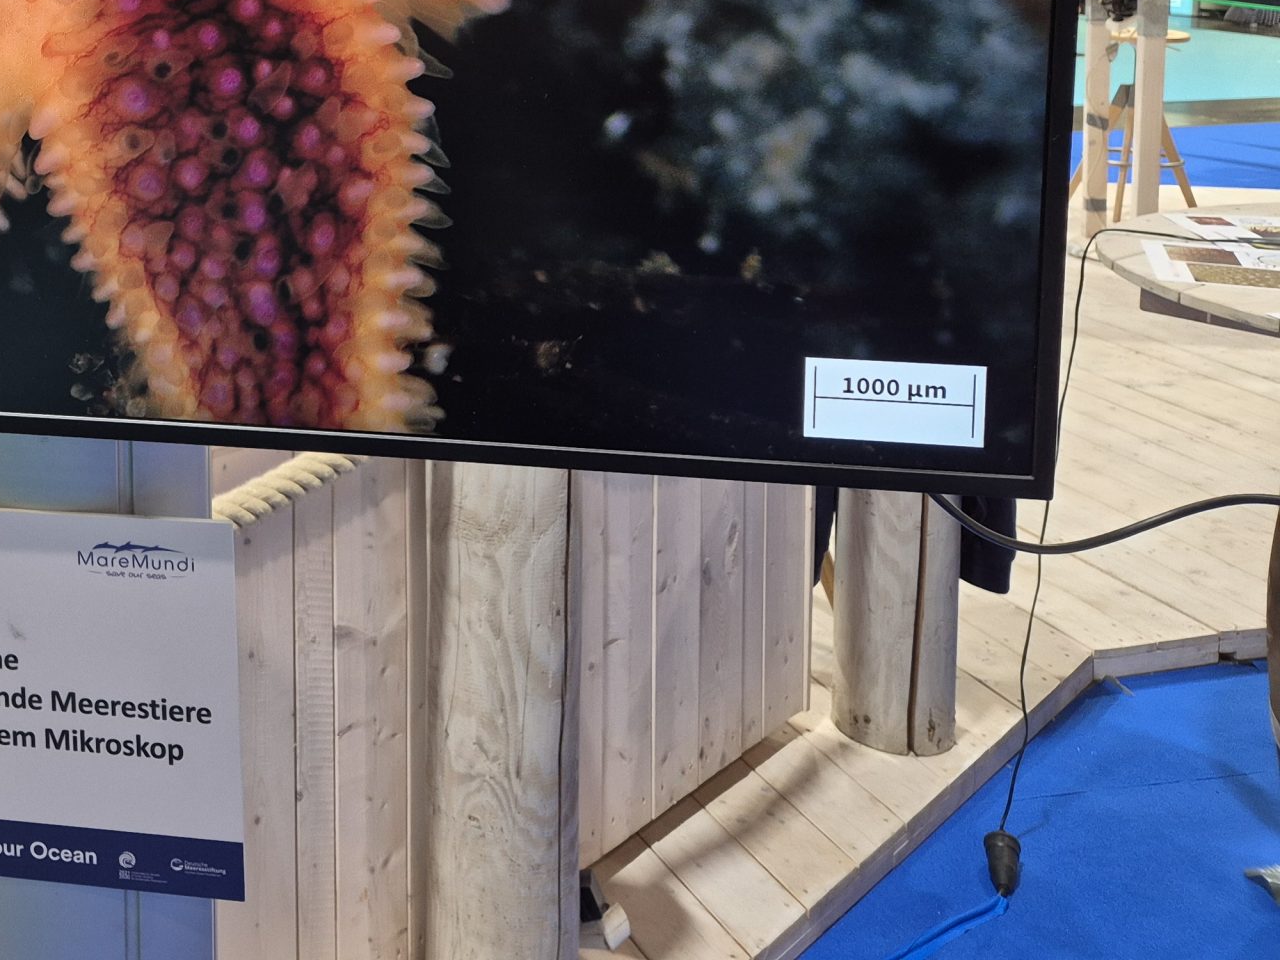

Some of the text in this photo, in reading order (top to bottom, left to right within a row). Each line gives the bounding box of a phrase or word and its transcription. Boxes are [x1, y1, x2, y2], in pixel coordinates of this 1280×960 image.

[842, 377, 899, 396] 1000
[77, 550, 195, 572] MareMundi
[51, 690, 212, 724] Meerestiere
[45, 728, 184, 765] Mikroskop
[30, 841, 98, 865] Ocean
